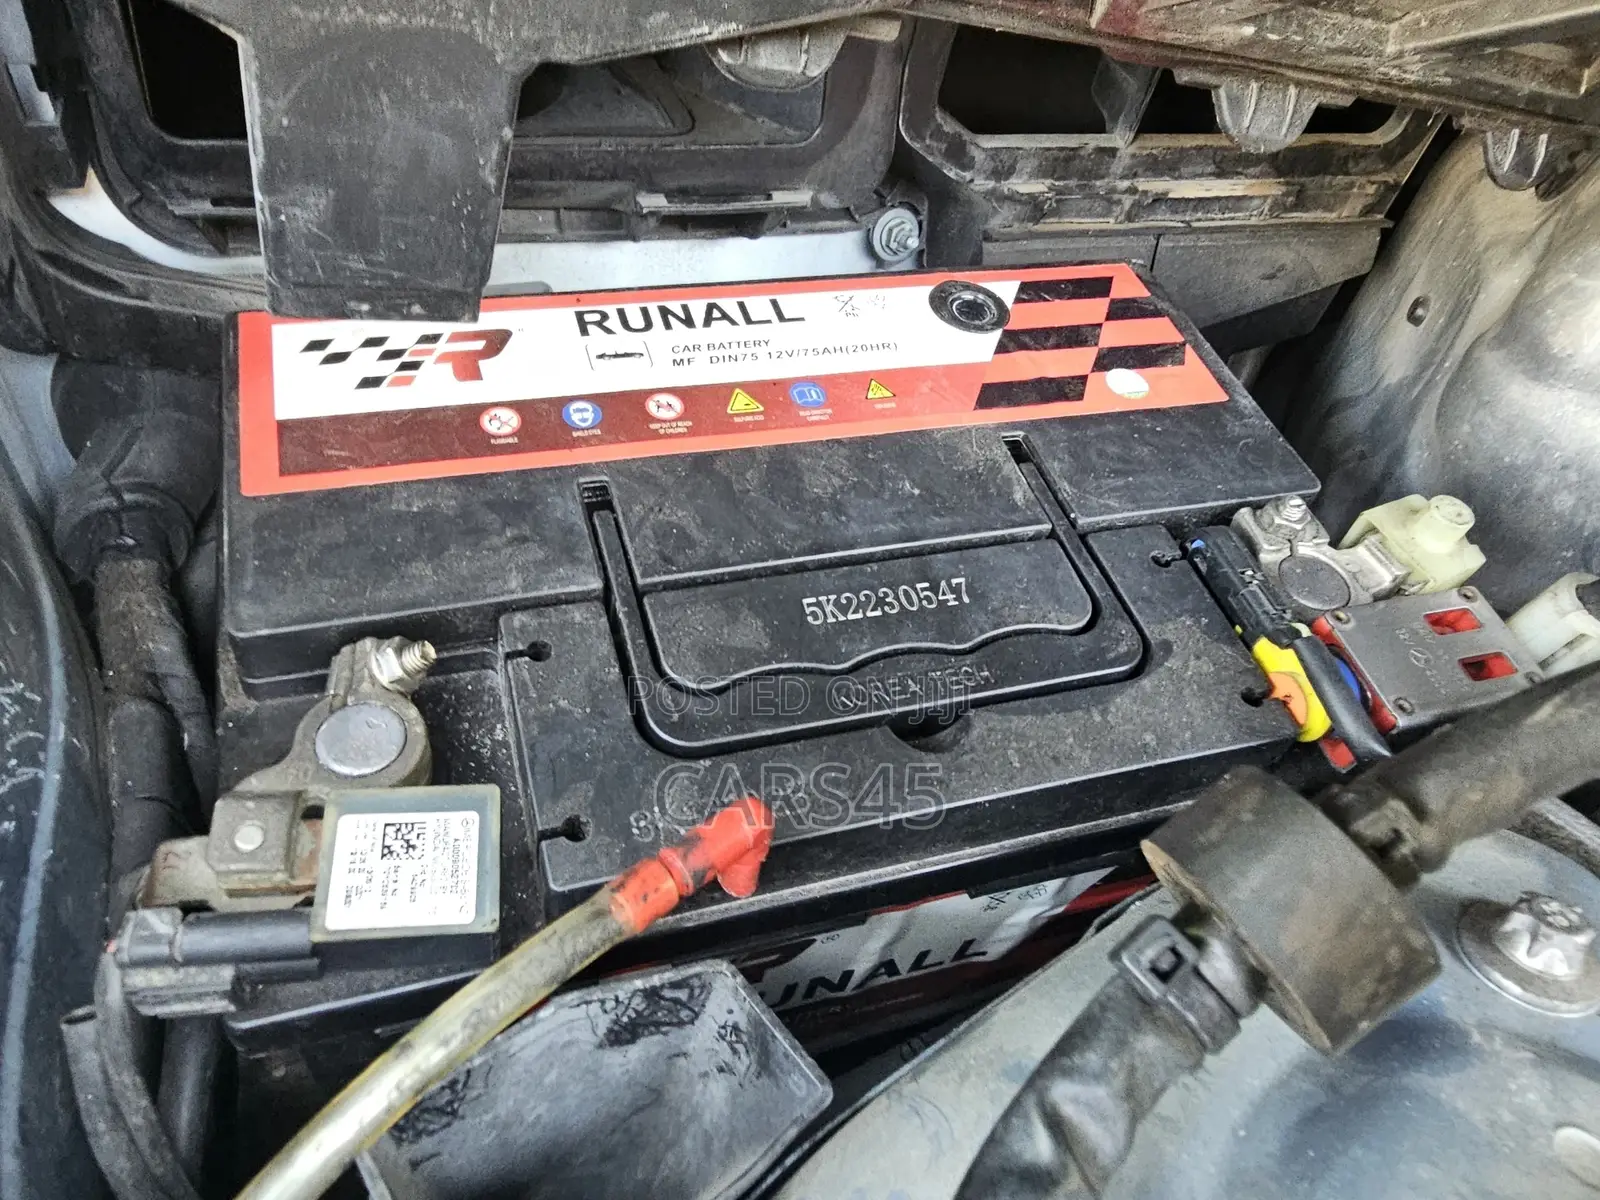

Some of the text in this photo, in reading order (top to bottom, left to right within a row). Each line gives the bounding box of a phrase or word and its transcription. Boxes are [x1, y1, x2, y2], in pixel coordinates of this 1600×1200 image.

[574, 298, 806, 338] RUNALL
[671, 339, 771, 355] CAR BATTERY
[672, 341, 898, 367] MF DIN75 12V/75AH(20HR)
[801, 577, 972, 626] 5K2230547
